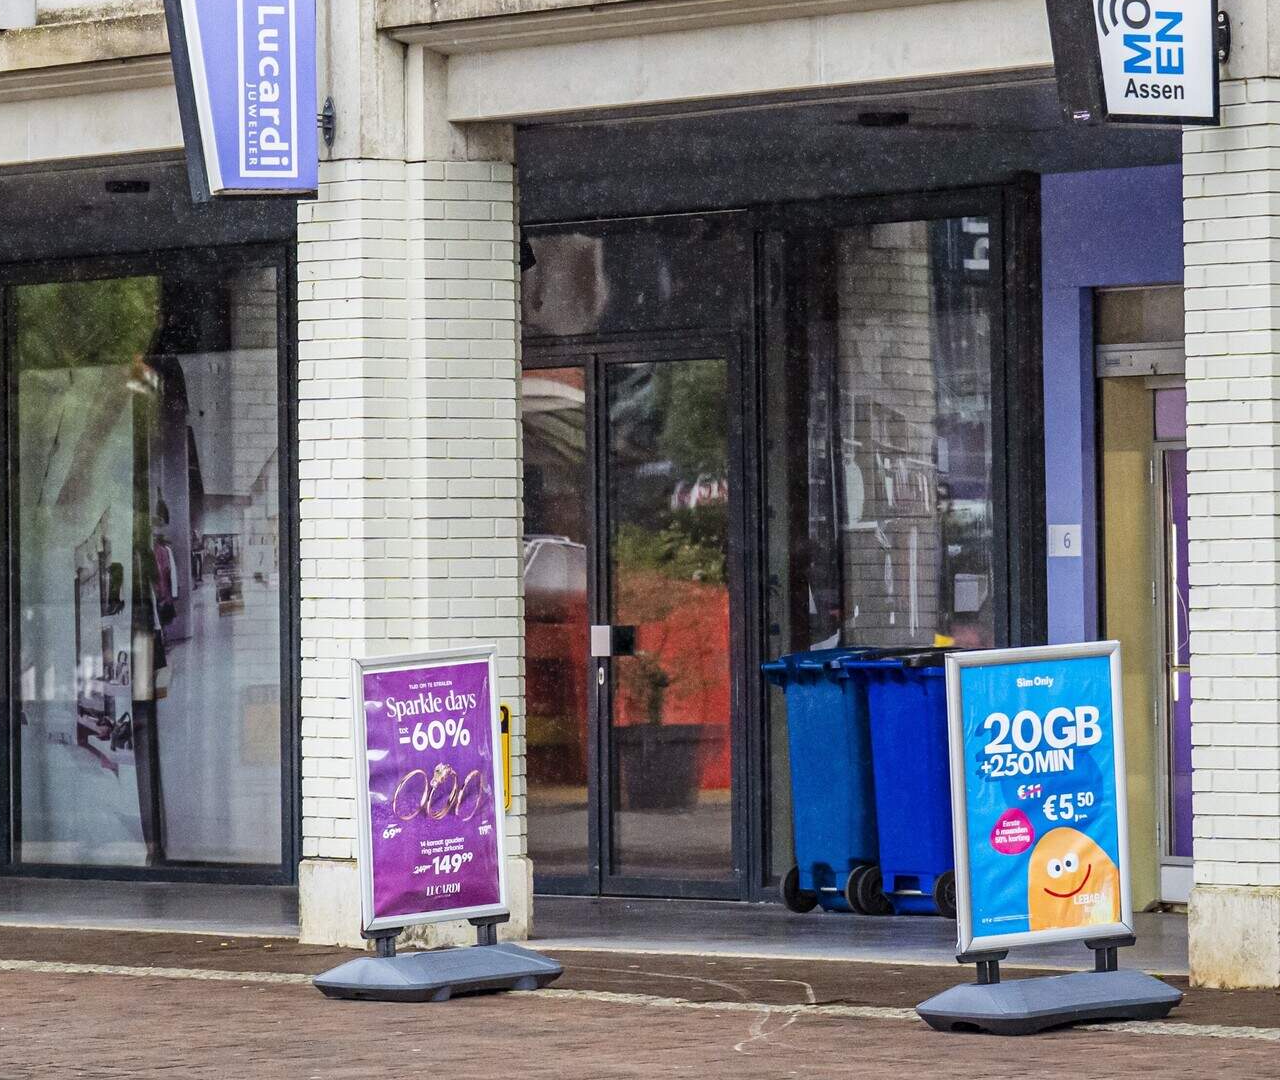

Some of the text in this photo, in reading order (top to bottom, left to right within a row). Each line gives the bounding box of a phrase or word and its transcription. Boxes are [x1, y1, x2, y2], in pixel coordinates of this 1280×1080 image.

[1155, 11, 1185, 76] EN
[257, 5, 289, 167] Lucardi
[1123, 77, 1185, 100] Assen
[246, 82, 258, 166] JUWELIER
[1063, 532, 1071, 549] 6
[1016, 676, 1054, 688] Sim Only
[386, 690, 477, 722] Sparkle days
[399, 718, 470, 751] -60%
[983, 705, 1103, 754] 20GB
[421, 848, 432, 856] ring
